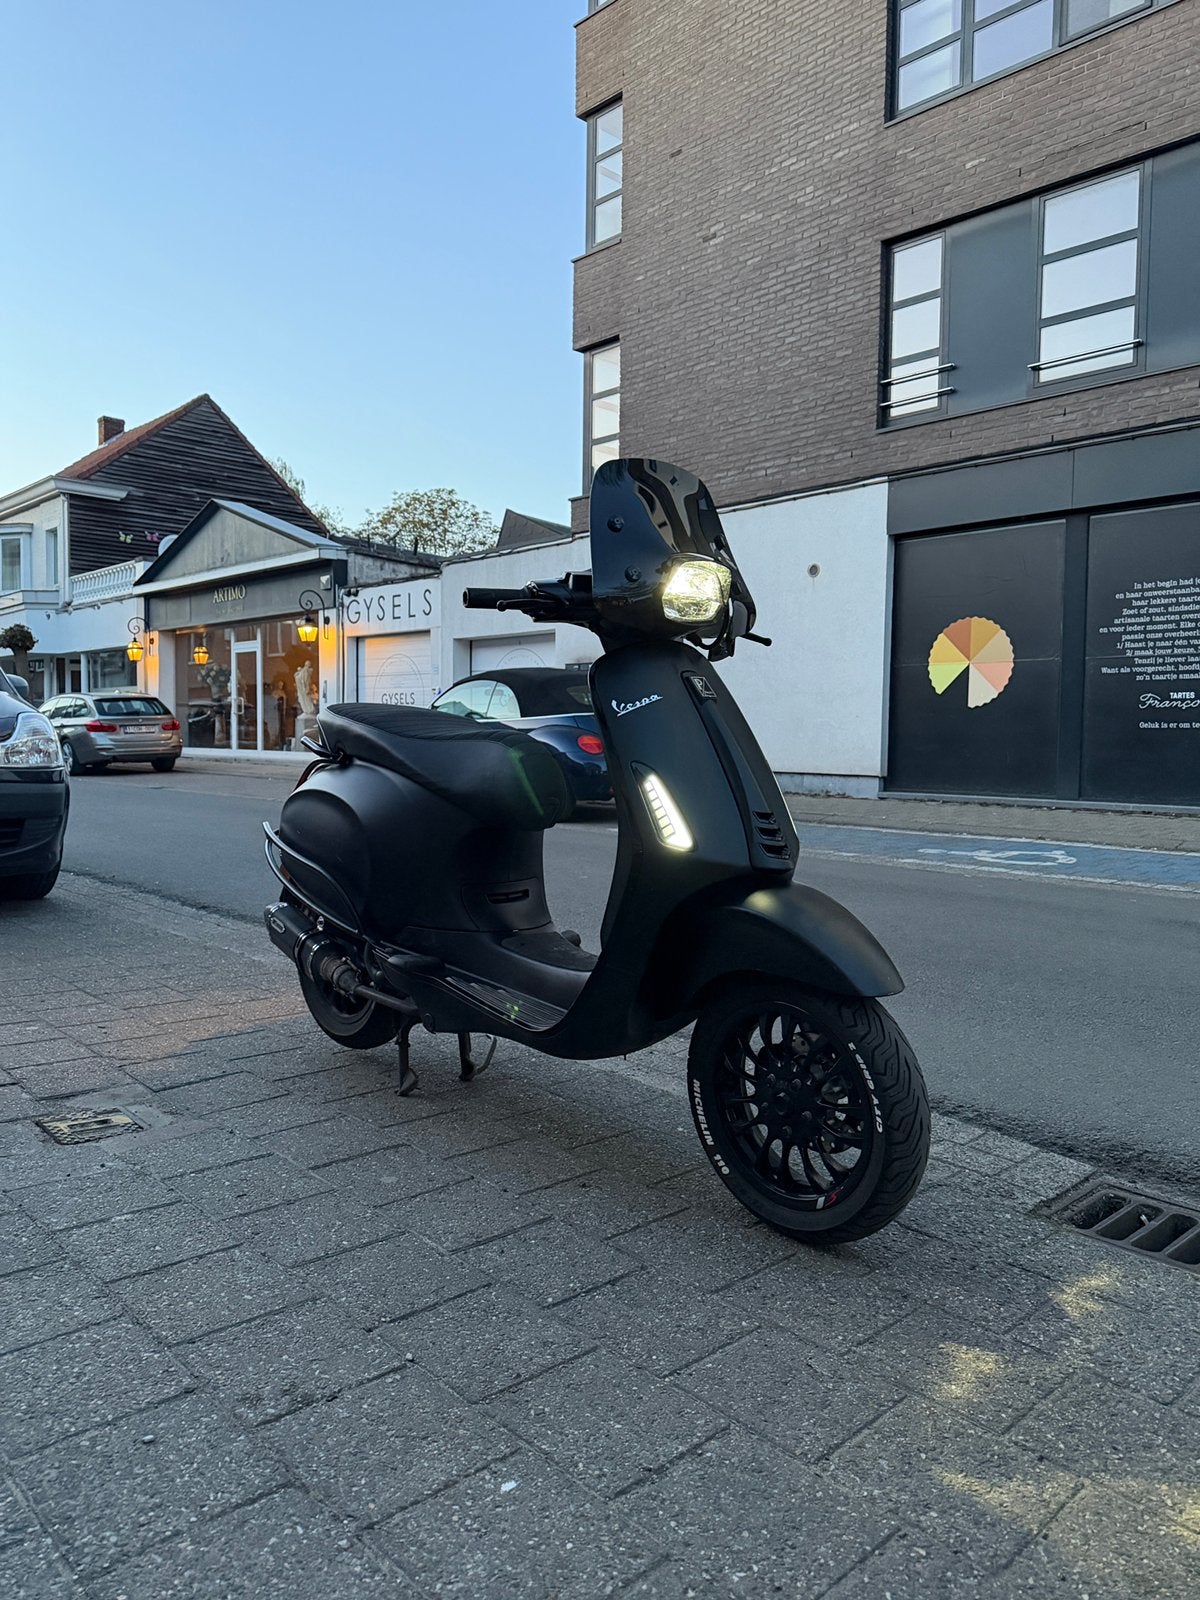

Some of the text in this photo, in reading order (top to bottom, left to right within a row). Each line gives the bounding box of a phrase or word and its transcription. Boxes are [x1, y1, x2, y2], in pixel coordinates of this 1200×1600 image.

[1143, 581, 1156, 589] het
[1157, 580, 1178, 588] begin
[1179, 577, 1193, 586] had
[212, 584, 246, 604] ARTIMO
[1125, 591, 1142, 599] haar
[1150, 597, 1177, 605] lekkere
[346, 588, 432, 624] GYSELS
[1113, 615, 1151, 624] artisanale
[1152, 614, 1180, 622] taarten
[1126, 624, 1145, 632] ieder
[1180, 620, 1196, 629] Elke
[1122, 632, 1145, 641] passie
[1124, 640, 1146, 648] Haast
[1147, 640, 1155, 648] je
[1134, 648, 1153, 656] maak
[1154, 647, 1172, 655] jouw
[1134, 656, 1155, 664] Tenzij
[1156, 656, 1164, 664] je
[1164, 655, 1187, 663] liever
[1101, 666, 1119, 674] Want
[1120, 665, 1131, 673] als
[1136, 673, 1151, 681] zo'n
[1152, 672, 1177, 681] taartje
[381, 691, 416, 705] GYSELS
[1169, 691, 1196, 699] TARTES
[611, 694, 663, 717] Vespa
[1138, 721, 1160, 729] Geluk
[1161, 721, 1168, 729] is
[855, 1053, 875, 1090] GRIP
[693, 1078, 715, 1146] MICHELIN
[871, 1093, 883, 1133] CITY
